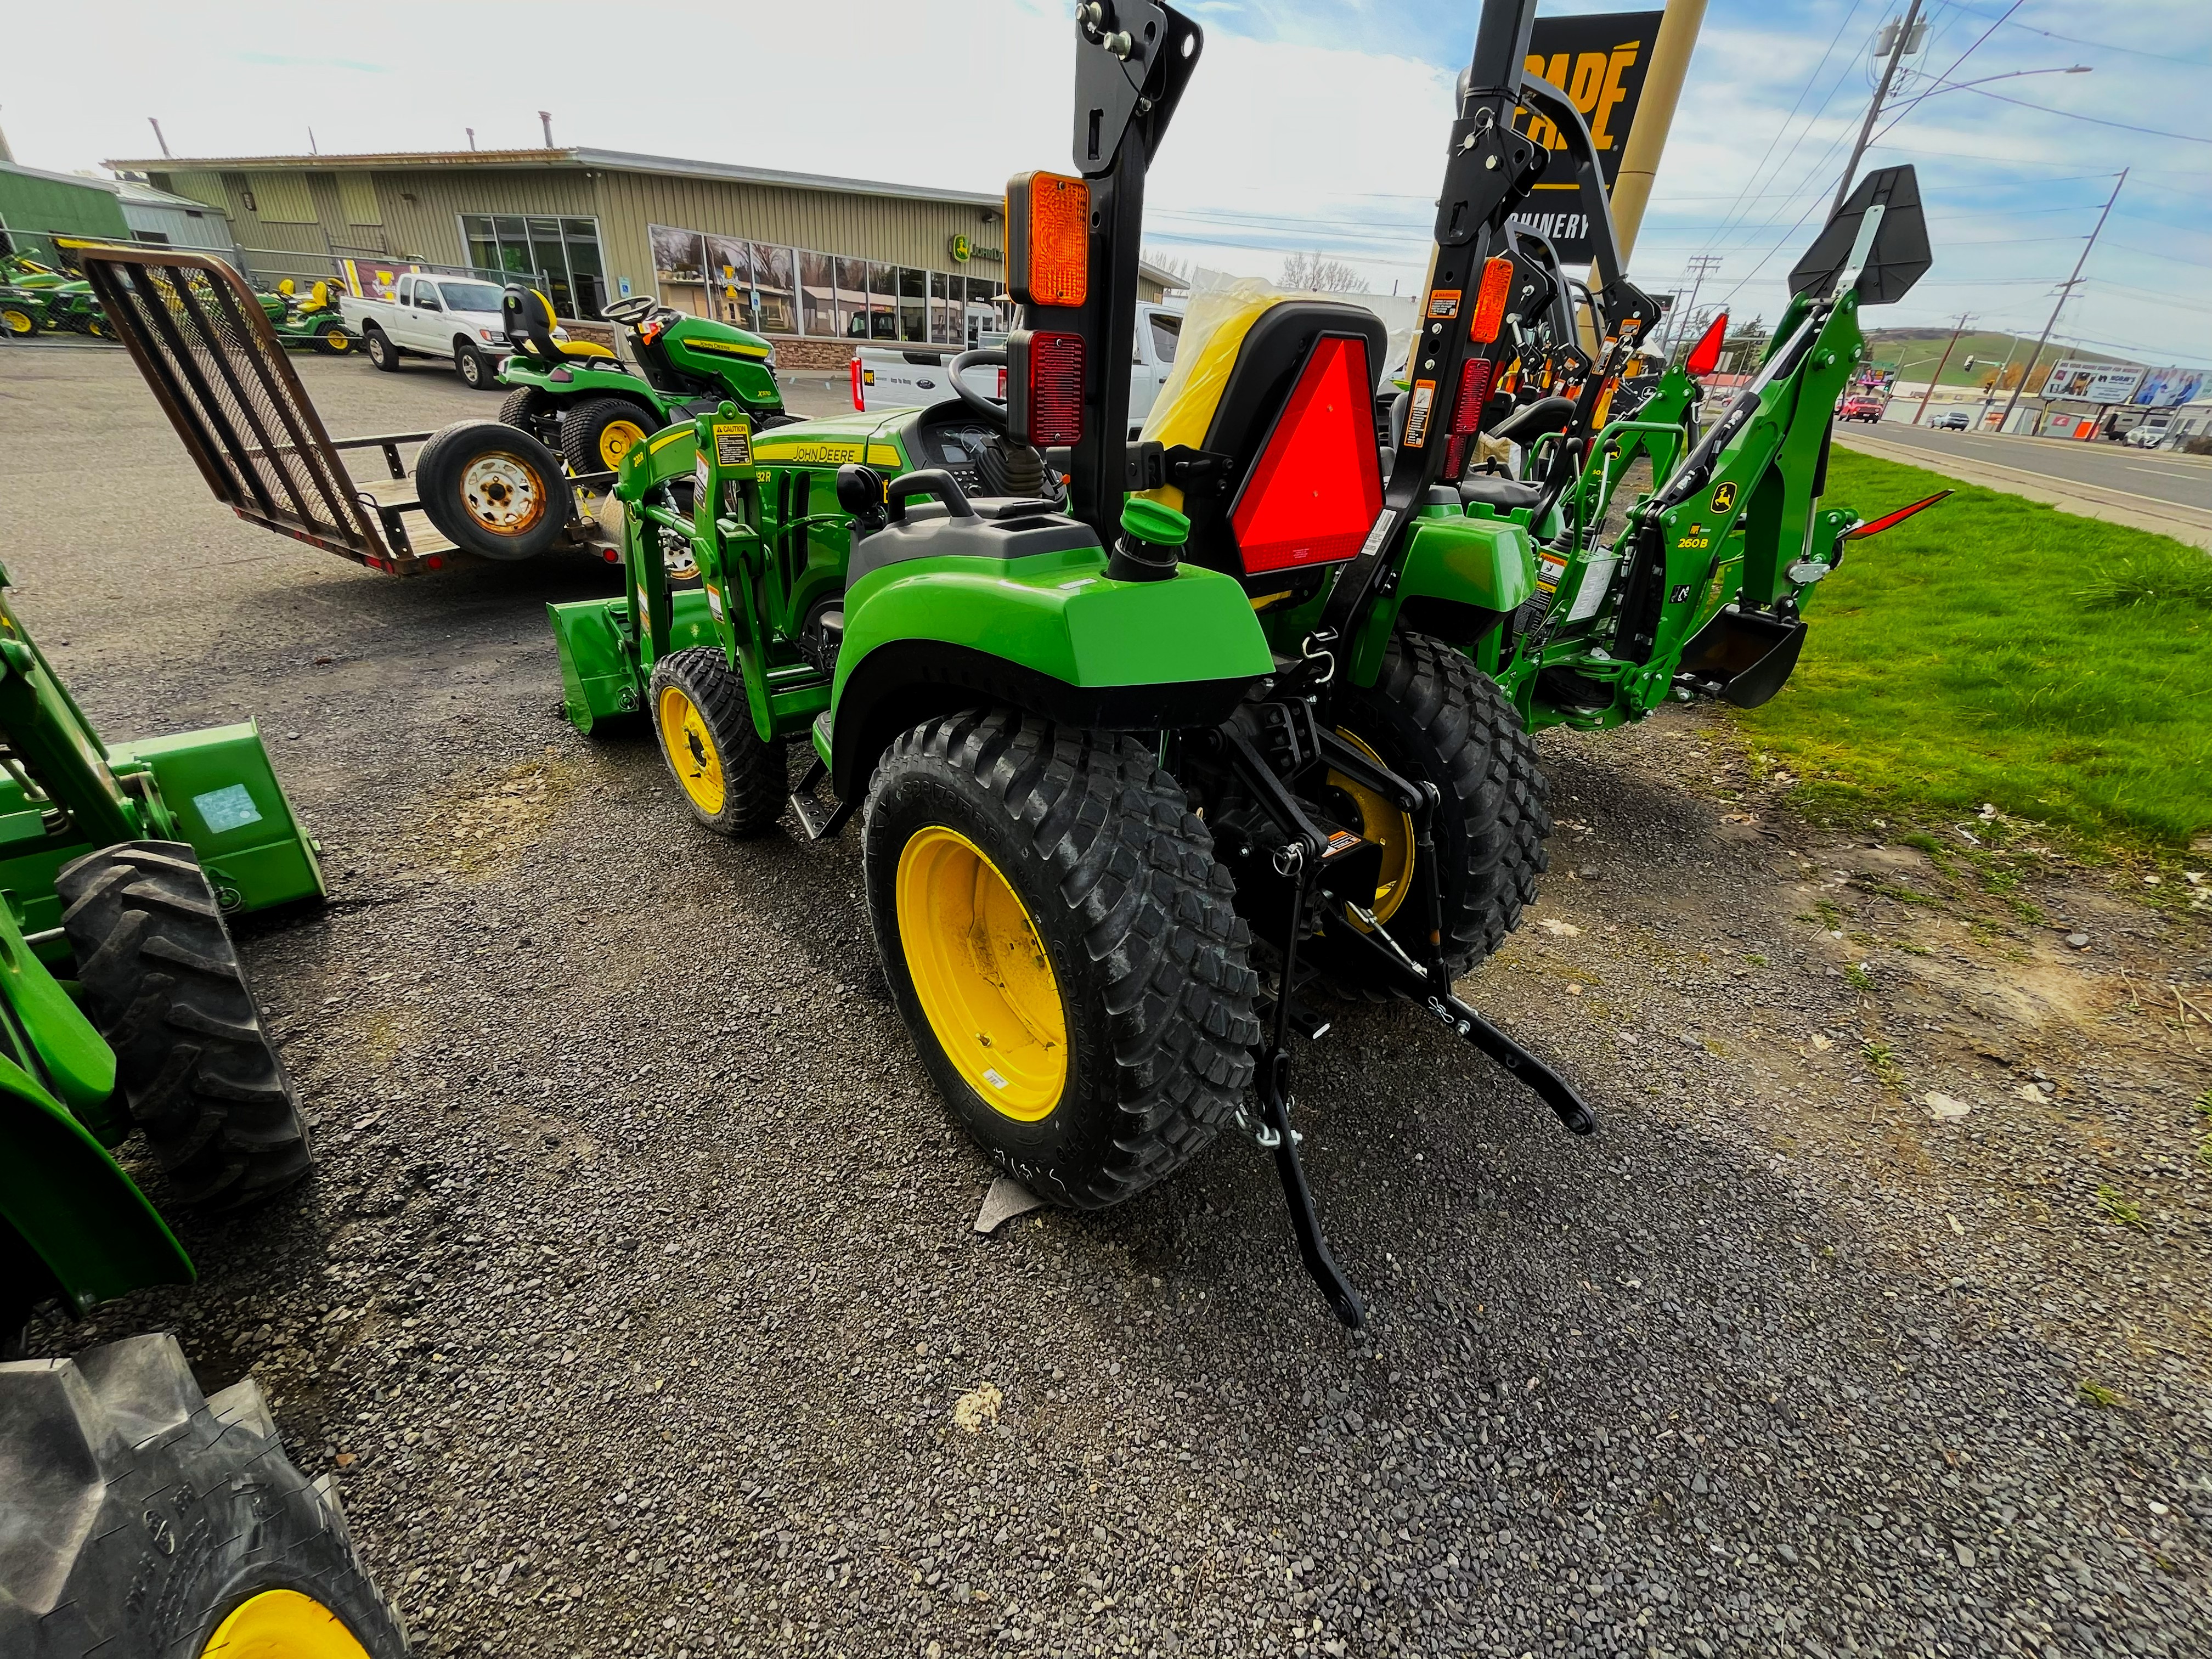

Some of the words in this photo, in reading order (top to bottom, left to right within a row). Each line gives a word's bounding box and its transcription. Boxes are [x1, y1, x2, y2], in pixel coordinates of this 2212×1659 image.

[972, 244, 994, 259] JOHN
[793, 445, 819, 460] JOHN
[819, 446, 855, 462] DEERE
[756, 470, 771, 483] 32R
[1537, 583, 1553, 591] AUTION
